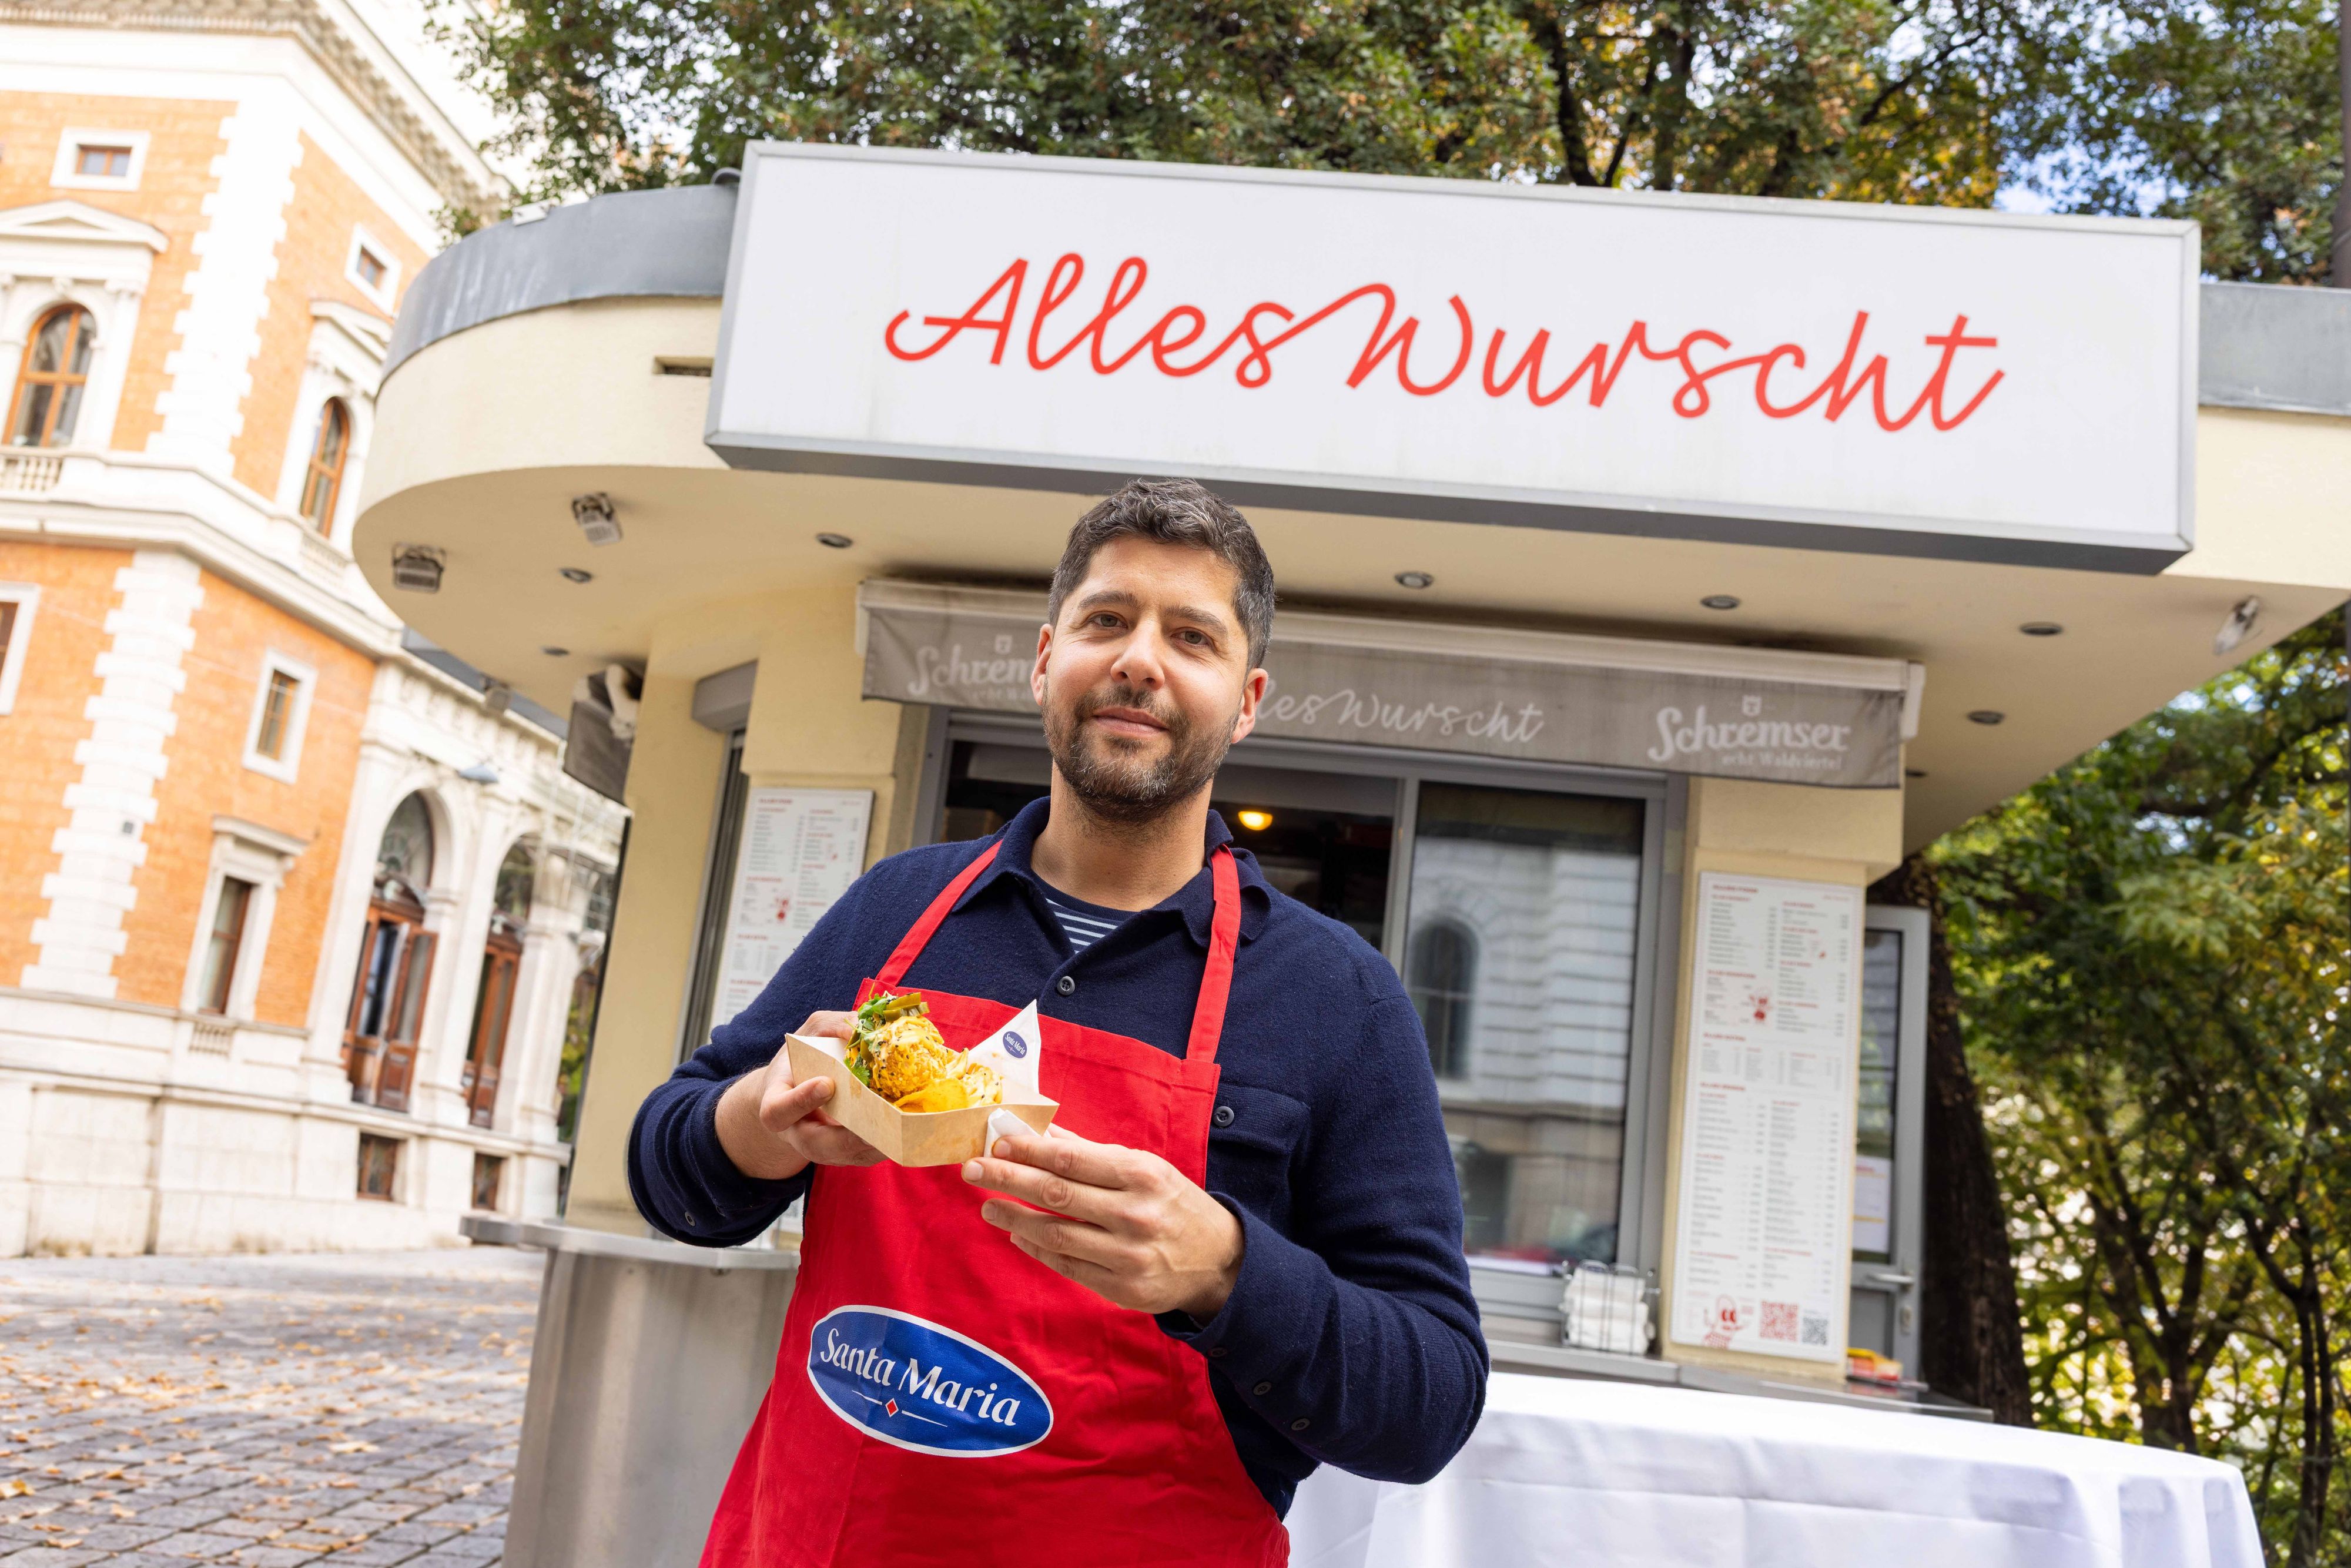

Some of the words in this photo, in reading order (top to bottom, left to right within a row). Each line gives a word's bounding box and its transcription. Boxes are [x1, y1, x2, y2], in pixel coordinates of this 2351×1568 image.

[1647, 705, 1851, 763] Schremser
[1005, 1033, 1016, 1046] Santa
[1013, 1041, 1026, 1055] Maria
[820, 1328, 896, 1386] Santa
[898, 1358, 1021, 1426] Maria
